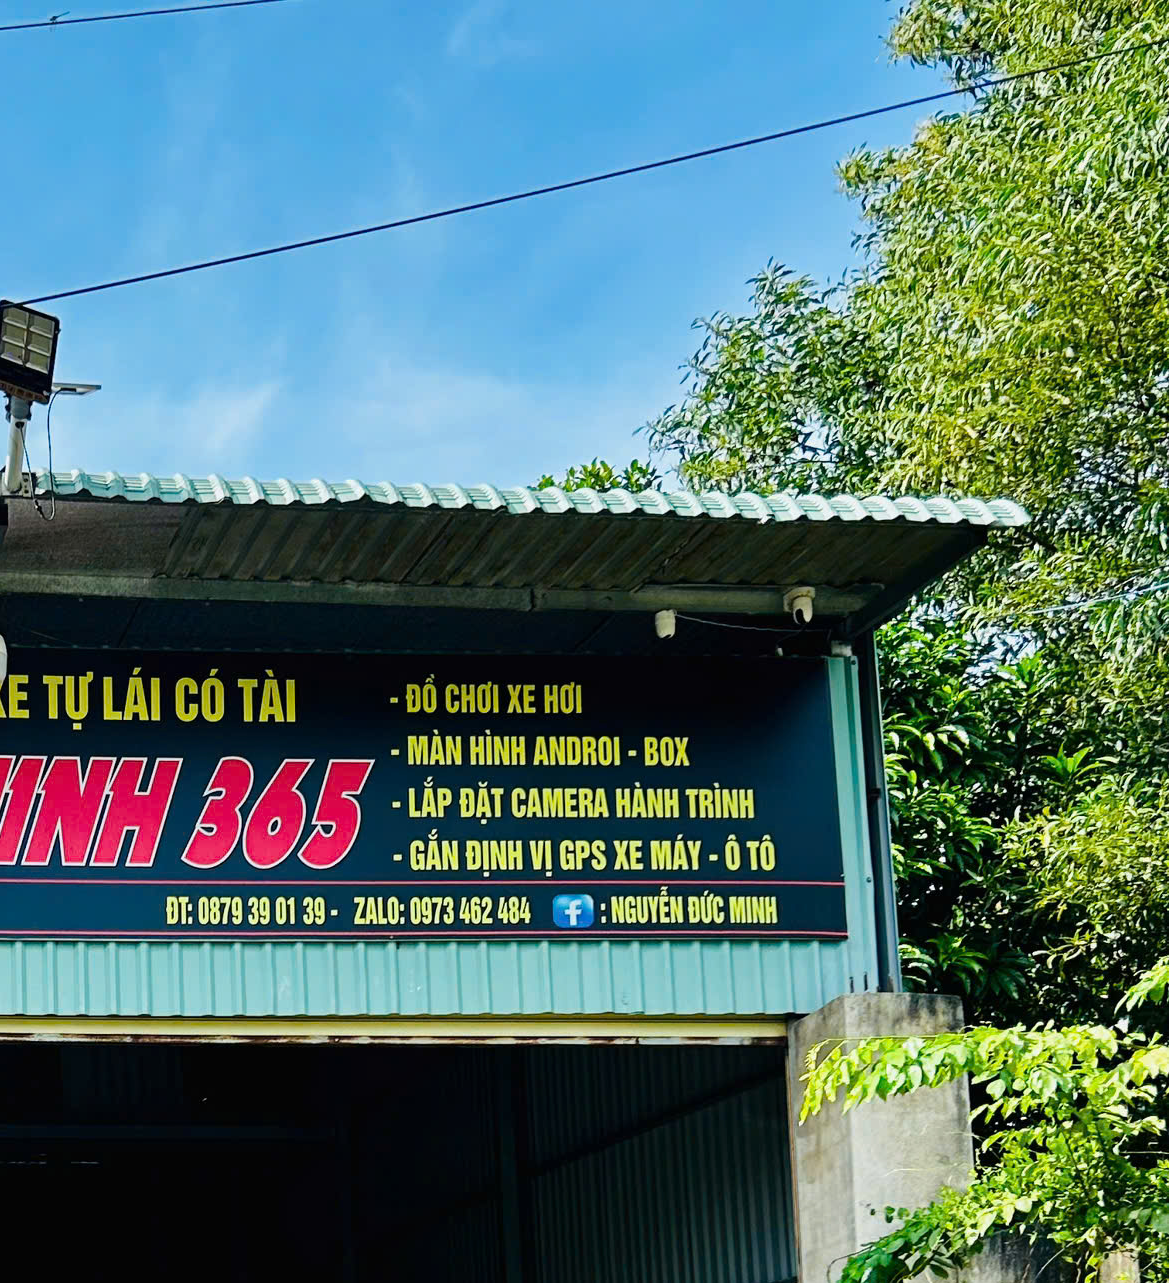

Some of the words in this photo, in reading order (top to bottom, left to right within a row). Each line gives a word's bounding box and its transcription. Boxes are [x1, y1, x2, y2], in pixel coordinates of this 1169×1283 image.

[42, 671, 93, 730] TỰ
[102, 666, 160, 721] LÁI
[175, 668, 224, 722] CÓ
[237, 669, 295, 722] TÀI
[405, 673, 436, 713] ĐỒ
[445, 681, 499, 713] CHƠI
[506, 684, 536, 713] XE
[543, 681, 582, 714] HƠI
[407, 728, 462, 765] MÀN
[469, 729, 526, 765] HÌNH
[532, 735, 620, 766] ANDROI
[643, 736, 689, 766] BOX
[181, 756, 375, 869] 365
[408, 775, 452, 817] LẮP
[458, 781, 504, 824] ĐẶT
[511, 787, 609, 818] CAMERA
[615, 781, 679, 818] HÀNH
[684, 782, 754, 818] TRÌNH
[409, 828, 458, 870] GẮN
[464, 839, 523, 877] ĐỊNH
[528, 839, 552, 877] VỊ
[559, 839, 606, 870] GPS
[612, 839, 643, 870] XE
[649, 833, 701, 870] MÁY
[724, 833, 740, 870] Ô
[745, 834, 775, 871] TÔ
[165, 895, 193, 924] ĐT:
[197, 896, 242, 924] 0879
[247, 896, 270, 925] 39
[275, 896, 295, 924] 01
[302, 896, 325, 924] 39
[353, 895, 405, 924] ZALO:
[409, 896, 454, 924] 0973
[459, 896, 493, 924] 462
[497, 896, 531, 924] 484
[610, 885, 684, 923] NGUYỄN
[687, 889, 724, 923] ĐỨC
[728, 895, 777, 923] MINH
